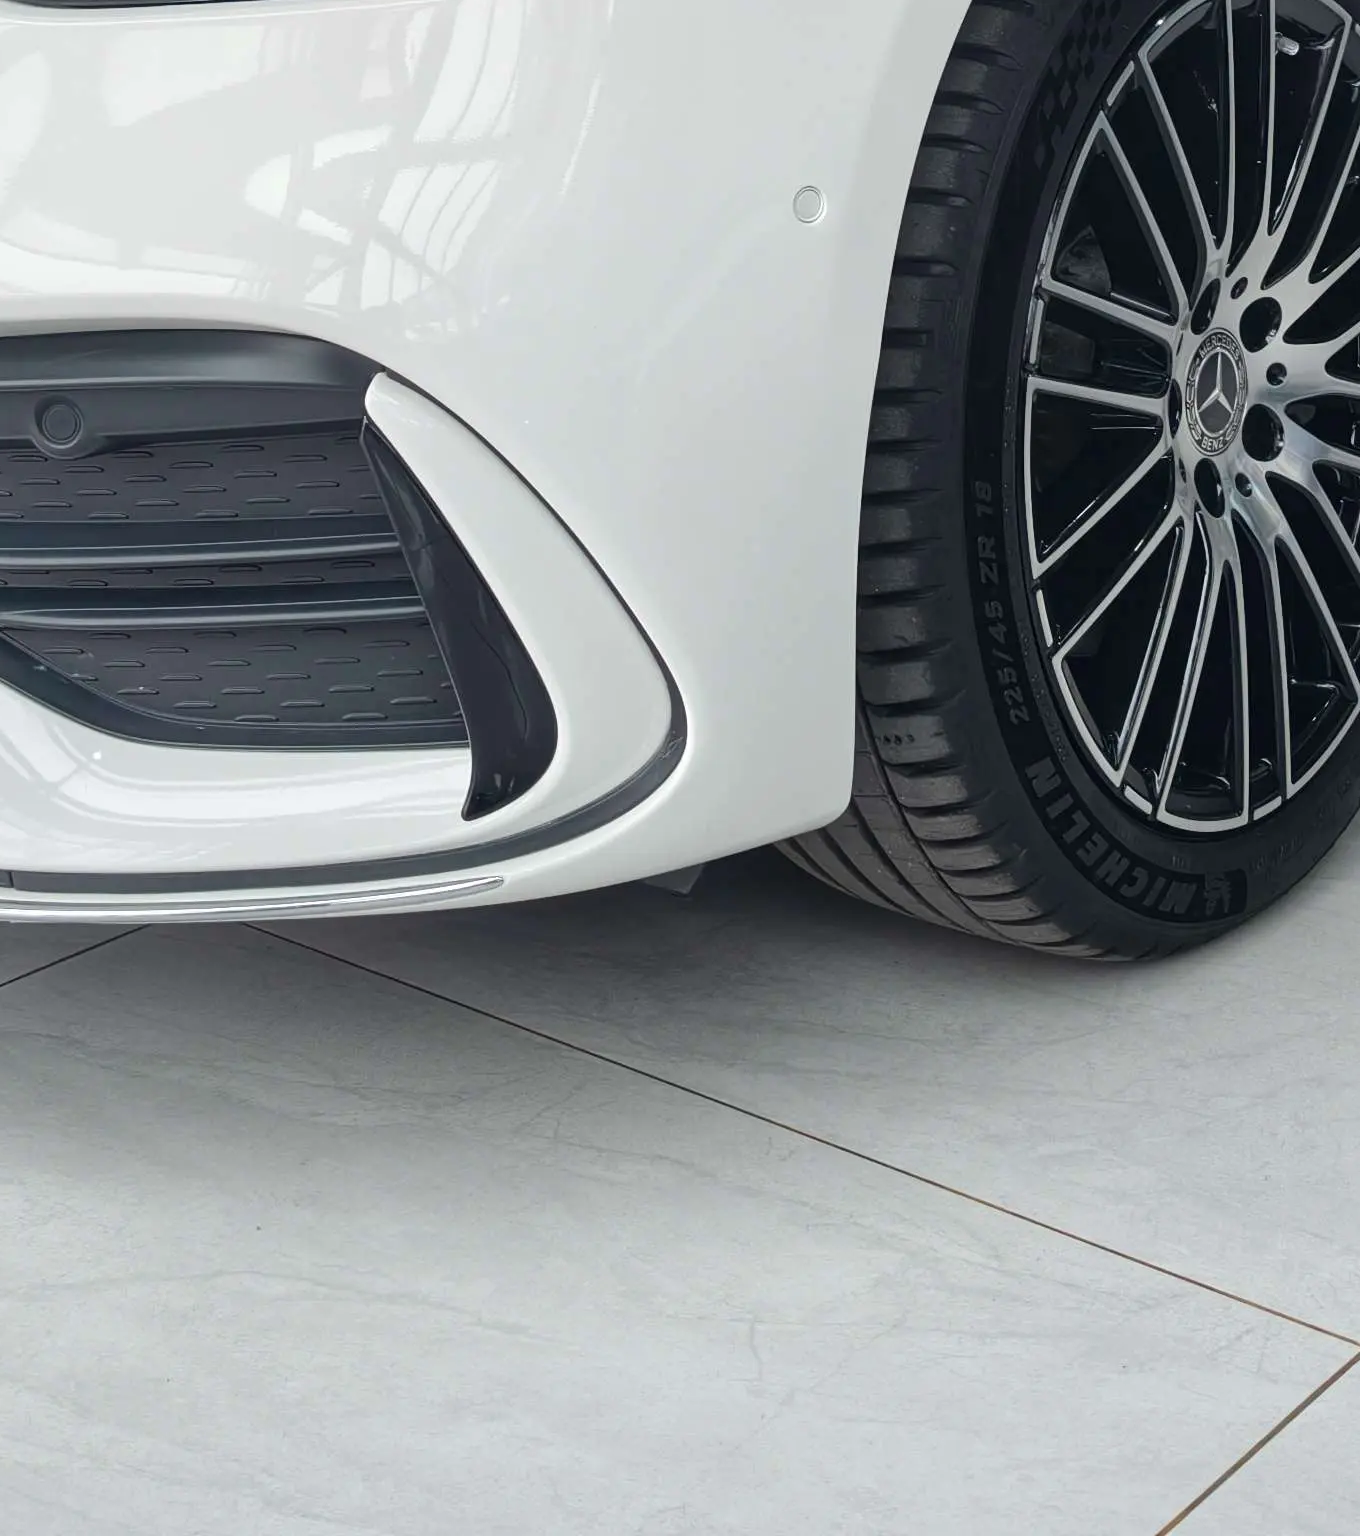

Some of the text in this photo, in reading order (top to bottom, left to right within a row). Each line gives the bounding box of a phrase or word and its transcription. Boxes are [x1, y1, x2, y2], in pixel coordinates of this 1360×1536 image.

[1198, 333, 1240, 361] MERCEDES
[1201, 437, 1224, 452] BENZ
[1024, 755, 1198, 916] MICHELIN
